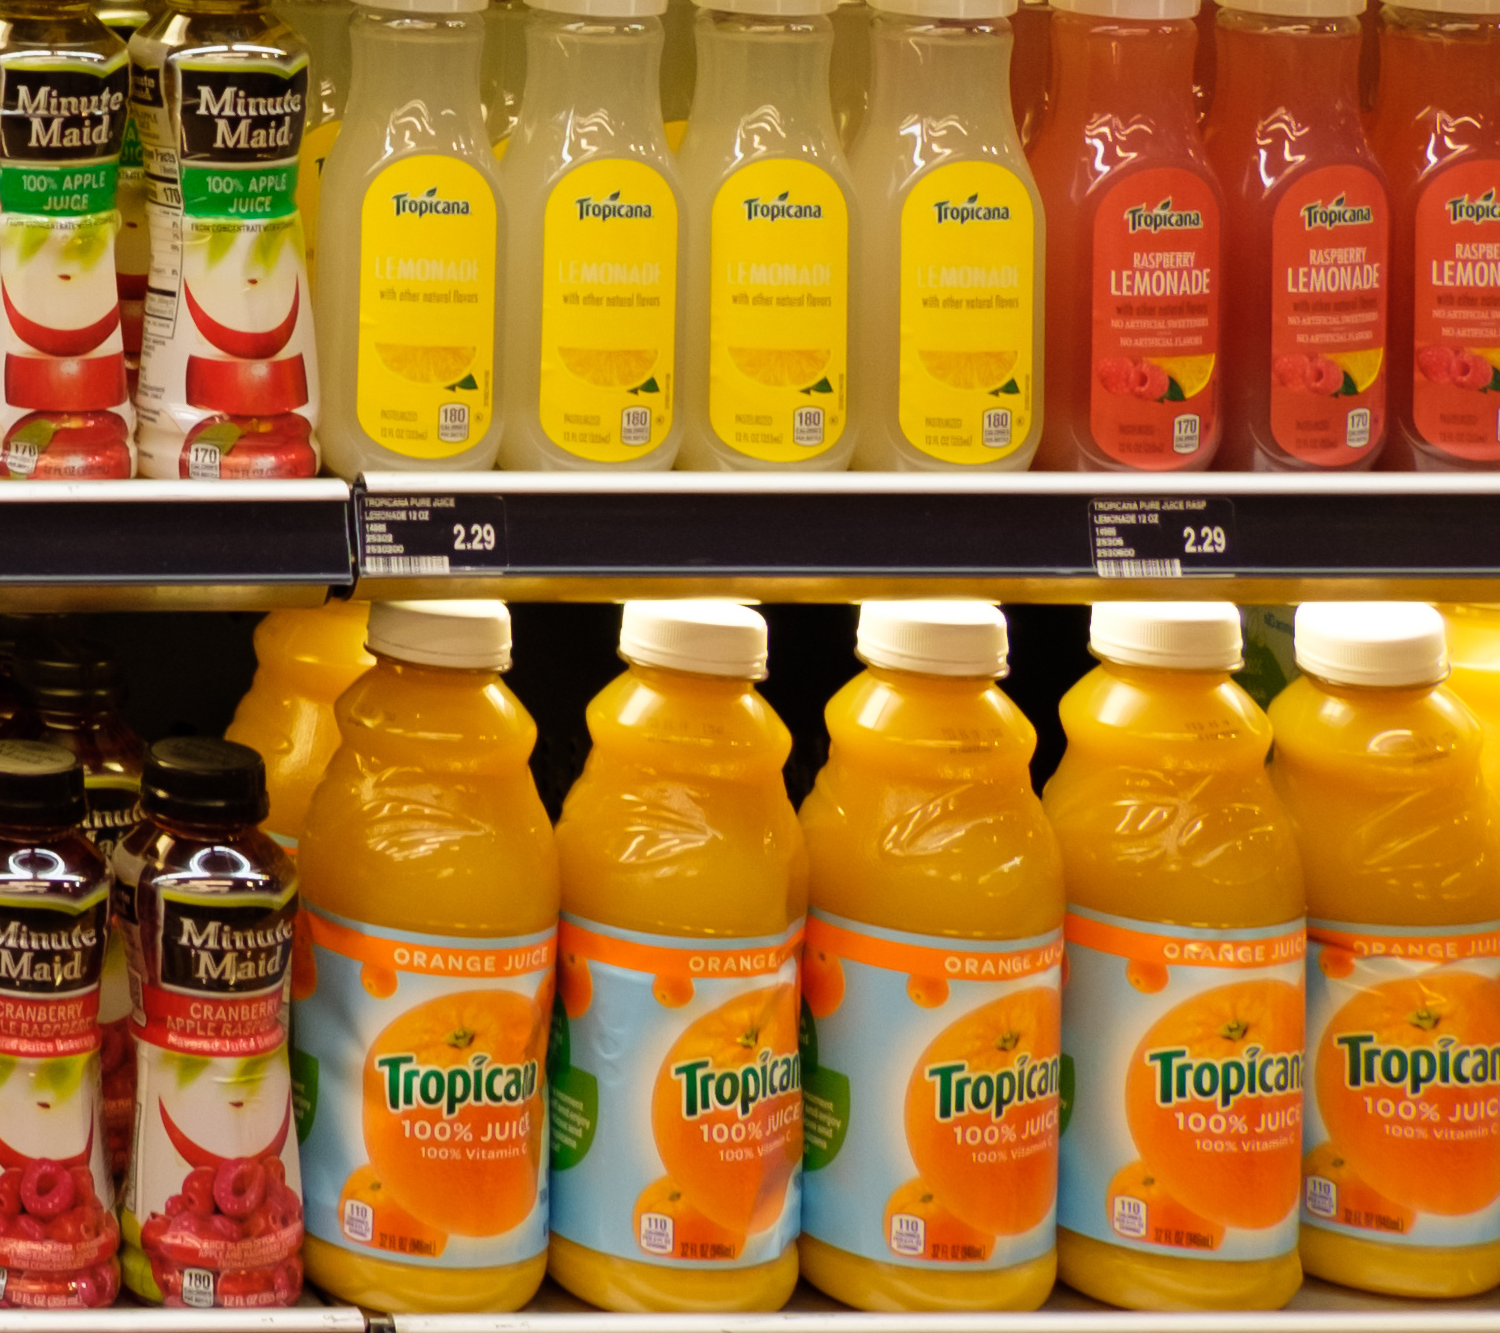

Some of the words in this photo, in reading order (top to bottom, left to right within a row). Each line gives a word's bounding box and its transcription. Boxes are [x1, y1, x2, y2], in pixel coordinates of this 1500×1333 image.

[392, 187, 471, 219] Tropicana
[1127, 197, 1202, 232] Tropicana
[1133, 251, 1195, 270] RASPBERRY
[1110, 268, 1210, 297] LEMONADE
[441, 407, 465, 424] 180
[453, 523, 496, 550] 2.29
[1183, 526, 1226, 553] 2.29
[394, 948, 496, 973] ORANGE
[503, 946, 548, 969] JUICE
[378, 1054, 537, 1117] Tropicana
[401, 1119, 474, 1143] 100%
[421, 1145, 461, 1161] 100%
[465, 1144, 520, 1161] Vitamin
